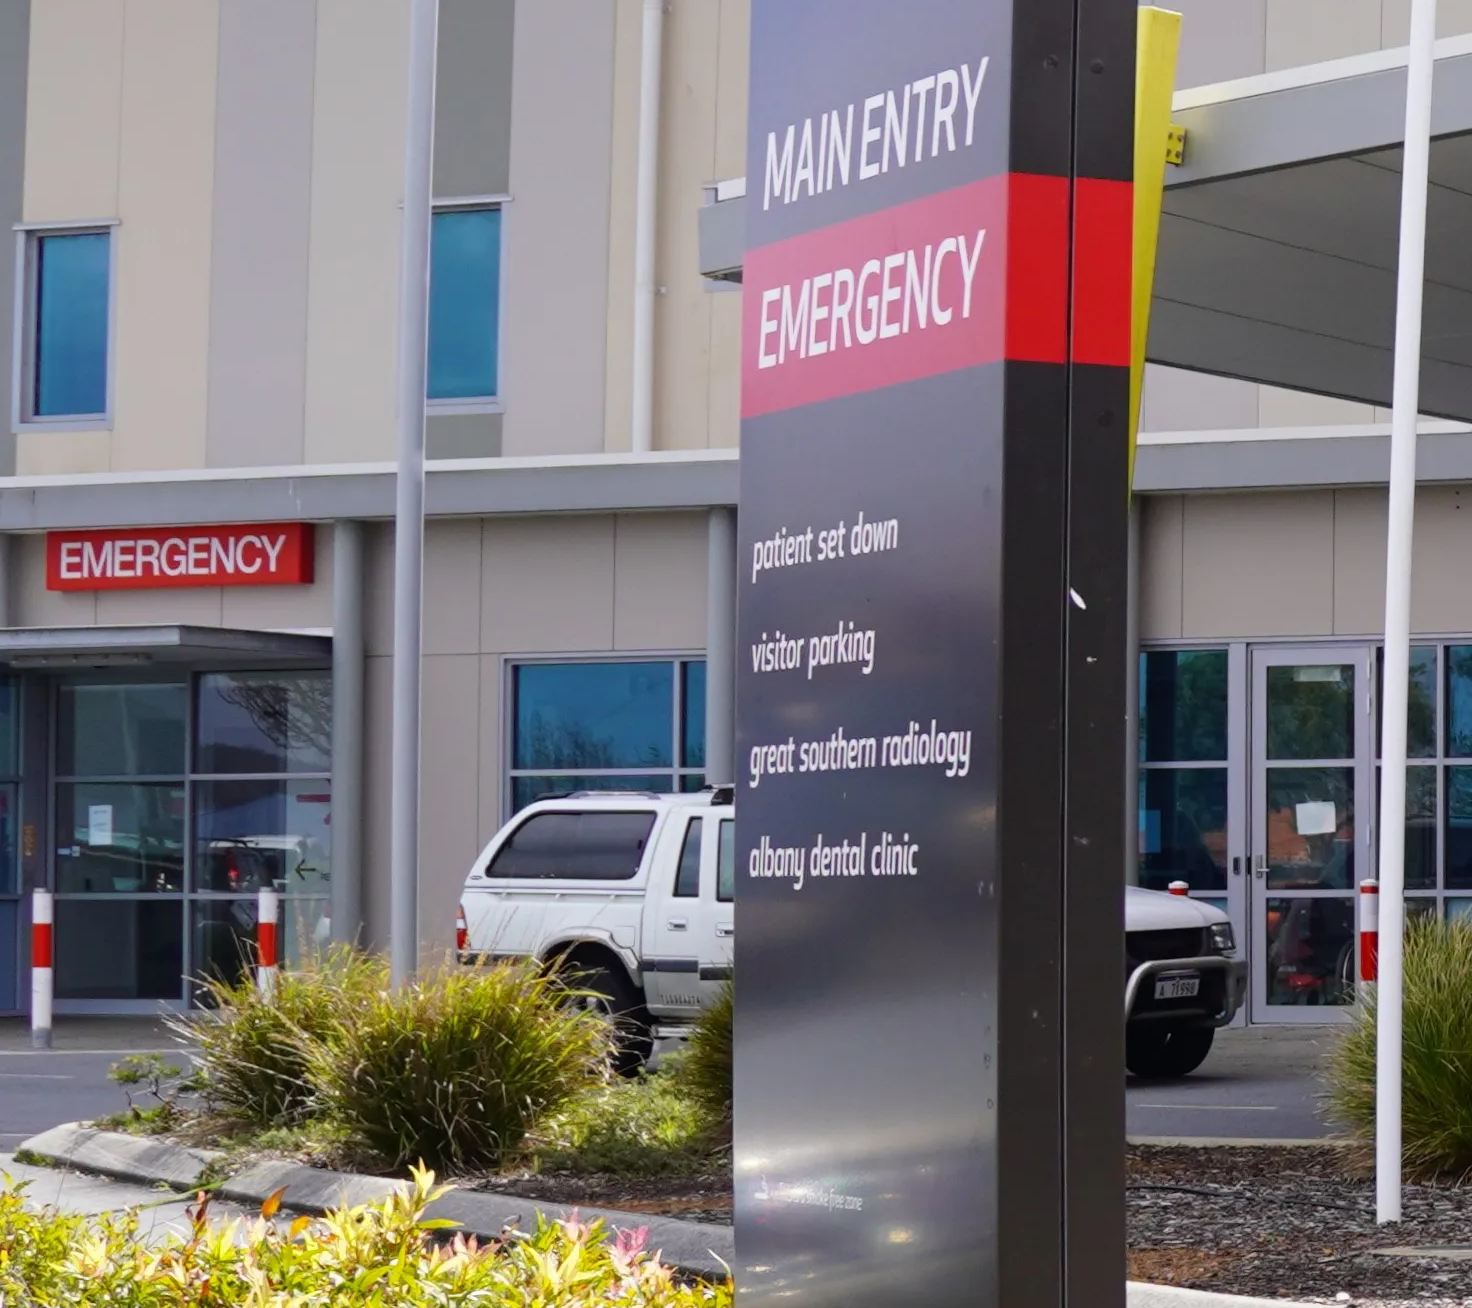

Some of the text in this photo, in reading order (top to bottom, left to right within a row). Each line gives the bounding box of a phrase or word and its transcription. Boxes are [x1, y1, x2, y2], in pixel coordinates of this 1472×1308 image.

[762, 56, 990, 211] MAIN ENTRY
[757, 229, 986, 370] EMERGENCY
[59, 535, 286, 579] EMERGENCY
[752, 511, 898, 583] patient set down
[751, 620, 875, 679] visitor parking
[749, 718, 972, 788] great southern radiology
[749, 832, 919, 890] albany dental clinic
[829, 1188, 844, 1212] free
[844, 1195, 863, 1211] zone
